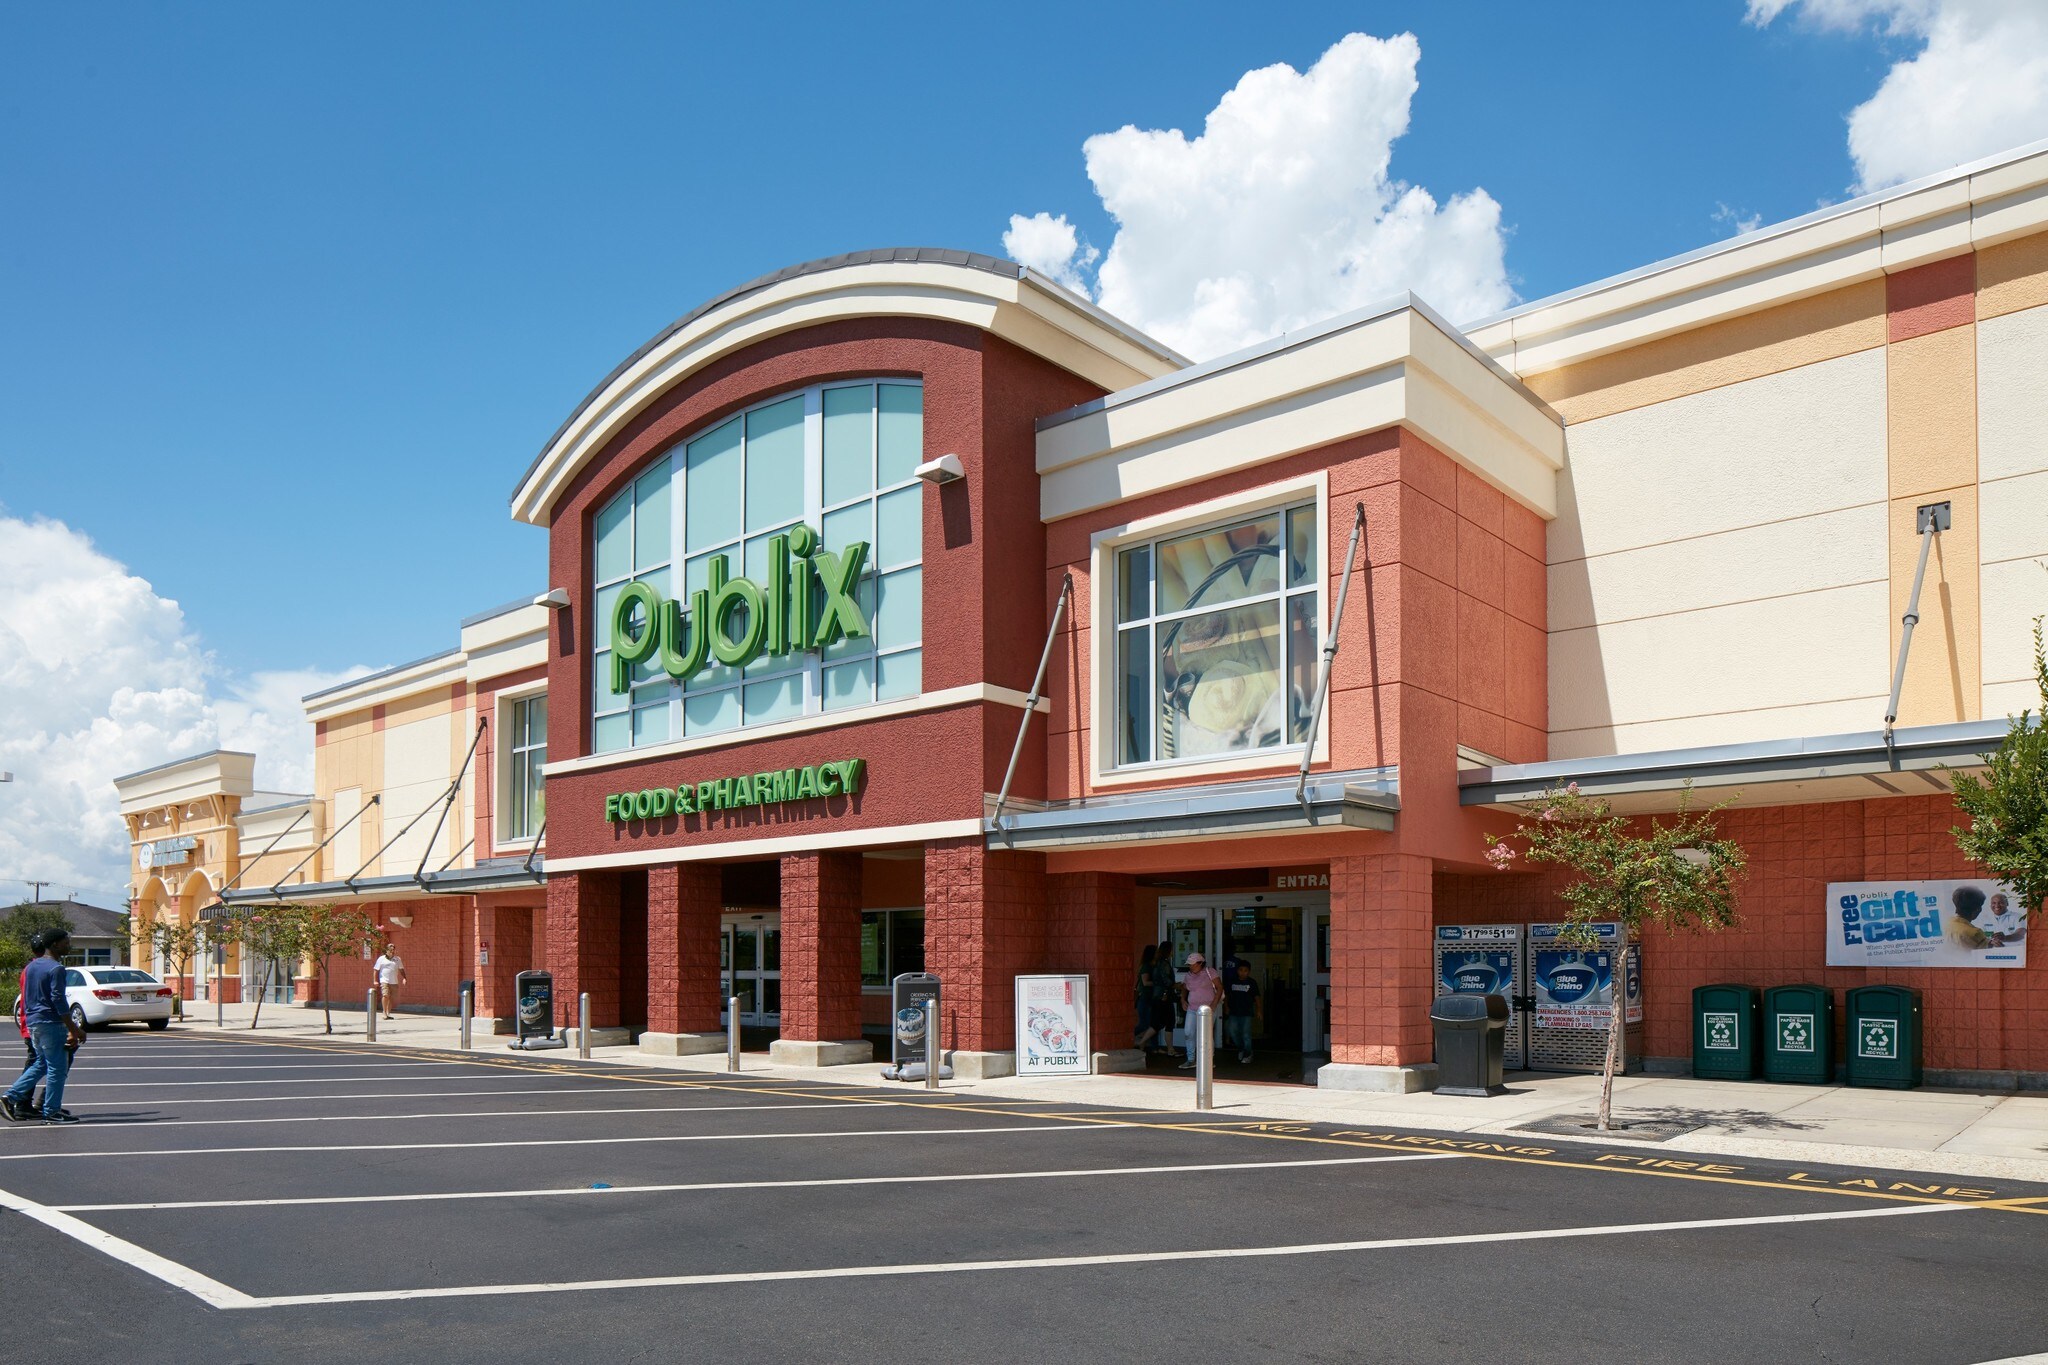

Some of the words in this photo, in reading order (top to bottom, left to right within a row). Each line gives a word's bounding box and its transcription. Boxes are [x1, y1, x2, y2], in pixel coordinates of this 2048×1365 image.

[611, 524, 871, 695] publix
[605, 787, 675, 823] FOOD
[675, 783, 697, 815] &
[696, 758, 866, 812] PHARMACY
[1277, 874, 1329, 888] ENTRA
[1861, 891, 1889, 900] Publix
[1860, 890, 1920, 921] Gift
[1028, 1057, 1040, 1066] AT
[1044, 1056, 1079, 1066] PUBLIX
[1242, 1124, 1312, 1133] NO
[1329, 1131, 1556, 1156] PARKING
[1595, 1154, 1745, 1174] FIRE
[1786, 1172, 1996, 1199] LANE
